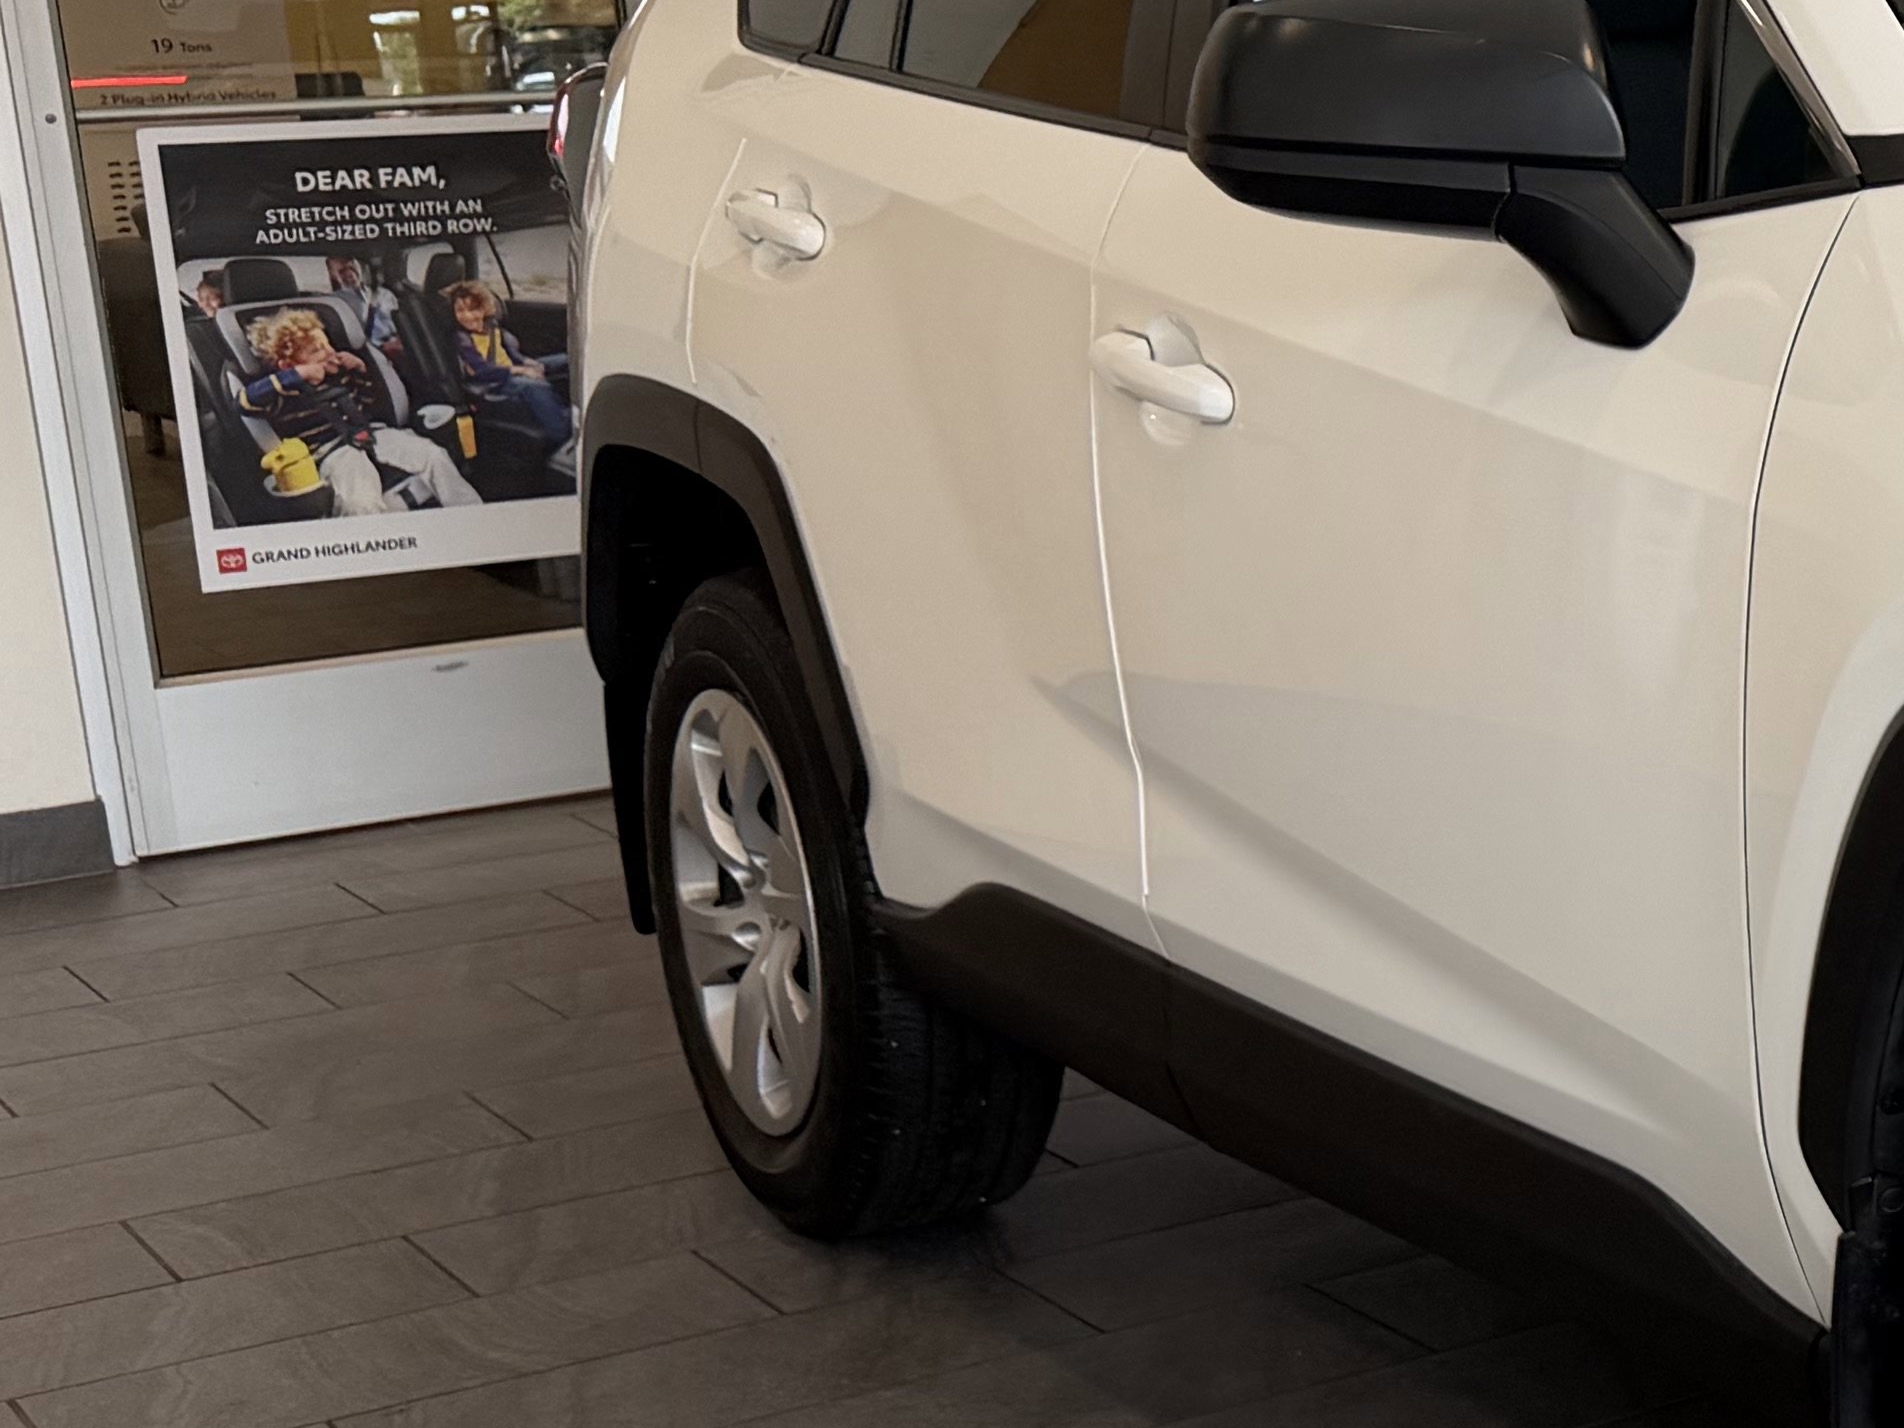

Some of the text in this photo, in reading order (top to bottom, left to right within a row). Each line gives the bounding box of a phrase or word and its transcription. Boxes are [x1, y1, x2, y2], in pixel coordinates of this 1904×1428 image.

[152, 38, 213, 54] 19 Tons
[295, 165, 446, 192] DEAR FAM,
[265, 198, 482, 224] STRETCH OUT WITH AN
[255, 217, 498, 245] ADULT-SIZED THIRD ROW.
[252, 535, 417, 565] GRAND HIGHLANDER
